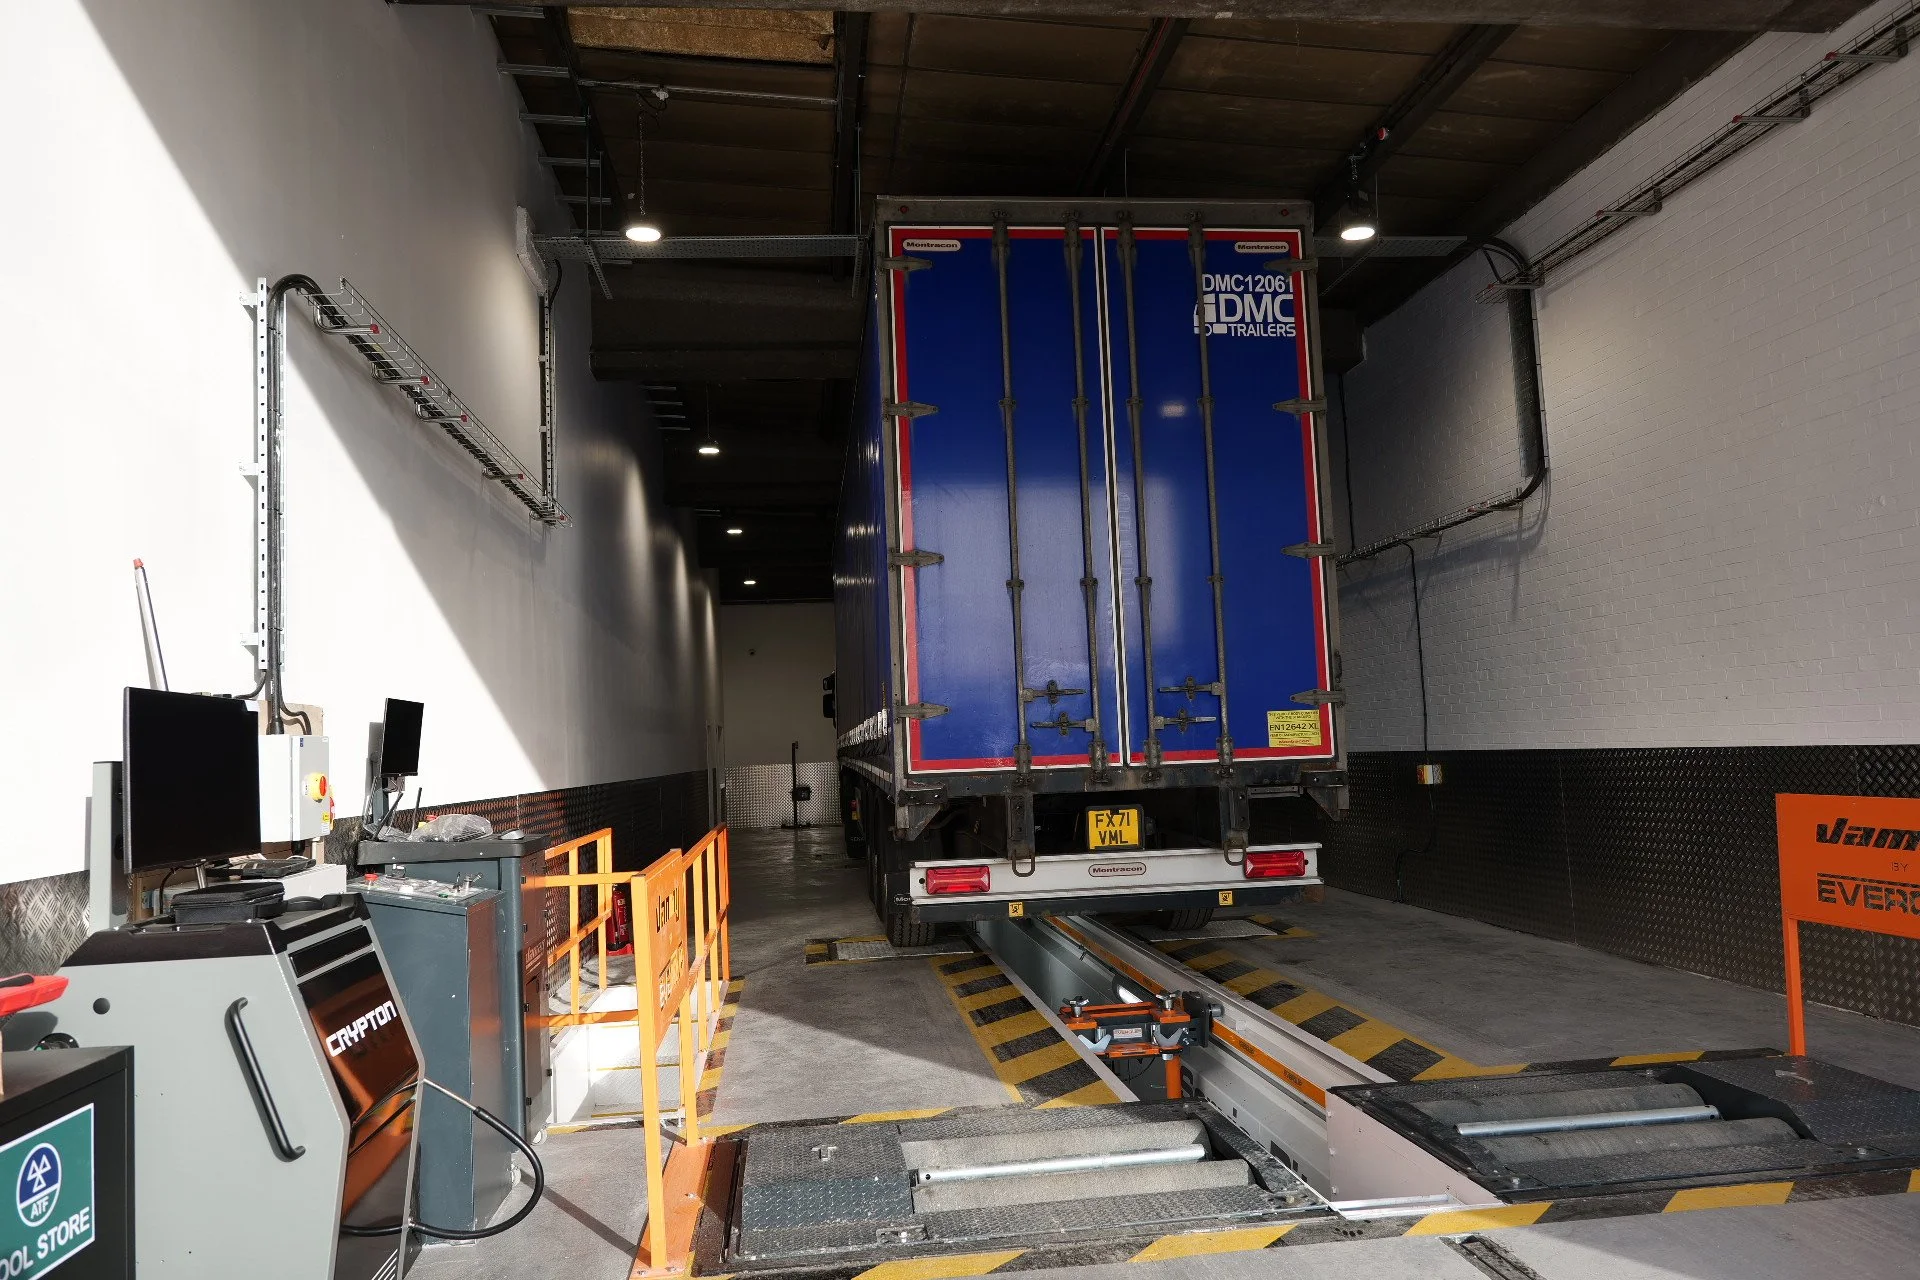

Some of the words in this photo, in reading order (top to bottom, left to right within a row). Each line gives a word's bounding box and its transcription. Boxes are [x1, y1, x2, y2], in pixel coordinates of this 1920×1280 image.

[1202, 273, 1294, 292] DMC12061
[1218, 293, 1295, 323] DMC
[1227, 323, 1297, 337] TRAILERS
[1269, 723, 1307, 731] EN12642
[1308, 722, 1320, 730] XL
[1095, 811, 1131, 828] FX71
[1098, 829, 1129, 845] VML
[1816, 817, 1920, 852] Jam
[1891, 862, 1908, 873] BY
[325, 1000, 398, 1058] CRYPTON
[30, 1195, 50, 1219] ATF
[37, 1206, 90, 1259] STORE
